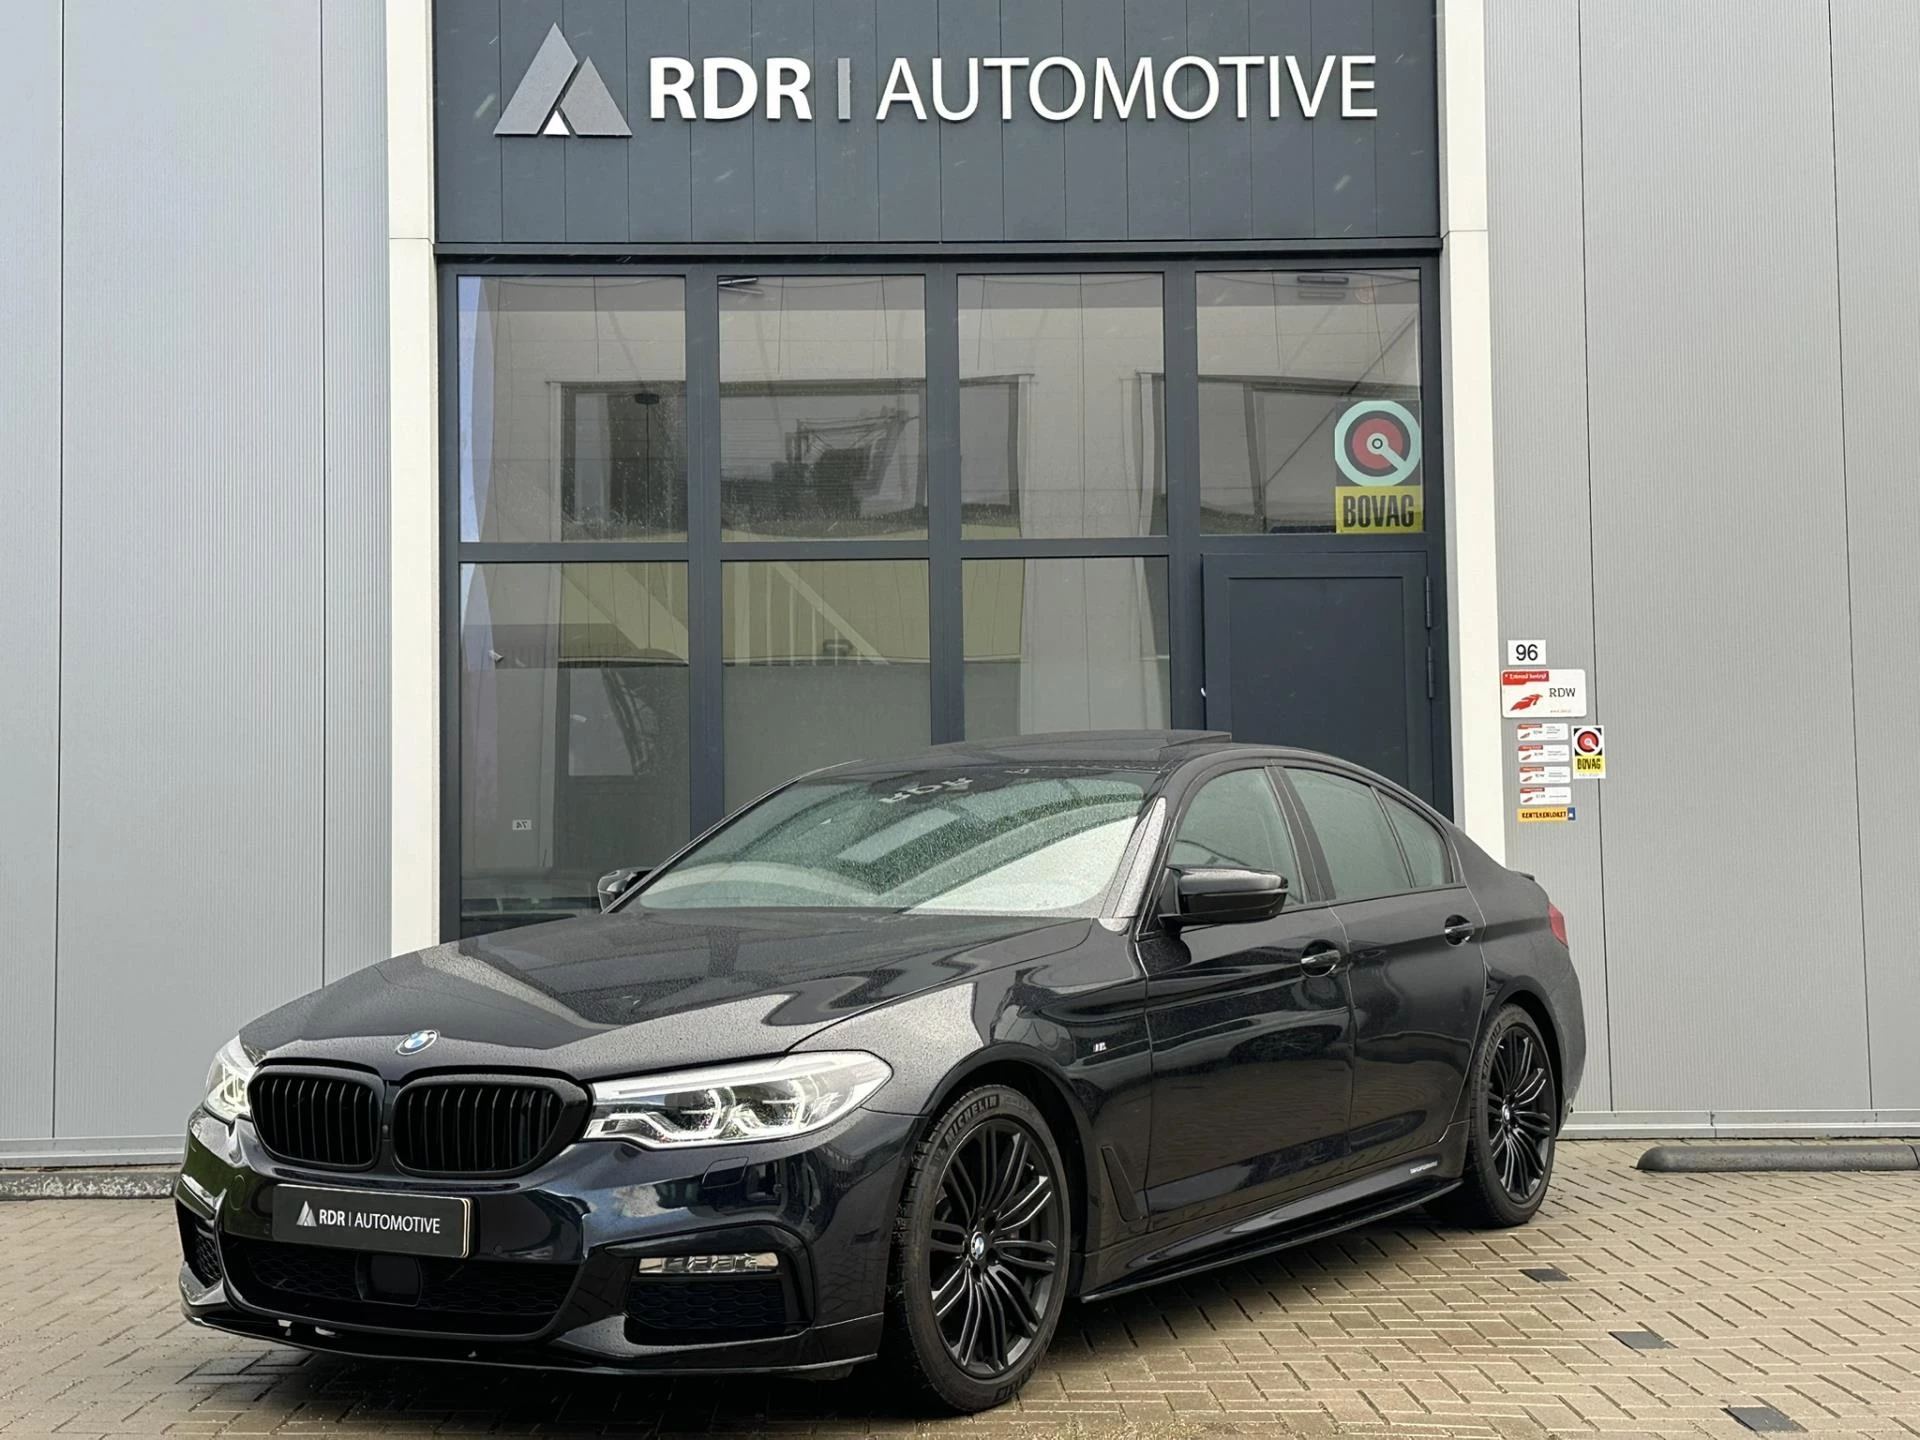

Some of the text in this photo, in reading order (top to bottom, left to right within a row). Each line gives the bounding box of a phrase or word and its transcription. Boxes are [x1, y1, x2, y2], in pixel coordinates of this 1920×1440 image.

[649, 54, 1378, 121] RDR AUTOMOTIVE
[1343, 494, 1414, 528] BOVAG
[1515, 644, 1538, 661] 96
[1549, 687, 1576, 698] RDW
[1576, 757, 1602, 770] BOVAG
[944, 1094, 999, 1145] MICHELIN
[319, 1209, 441, 1234] RDR AUTOMOTIVE
